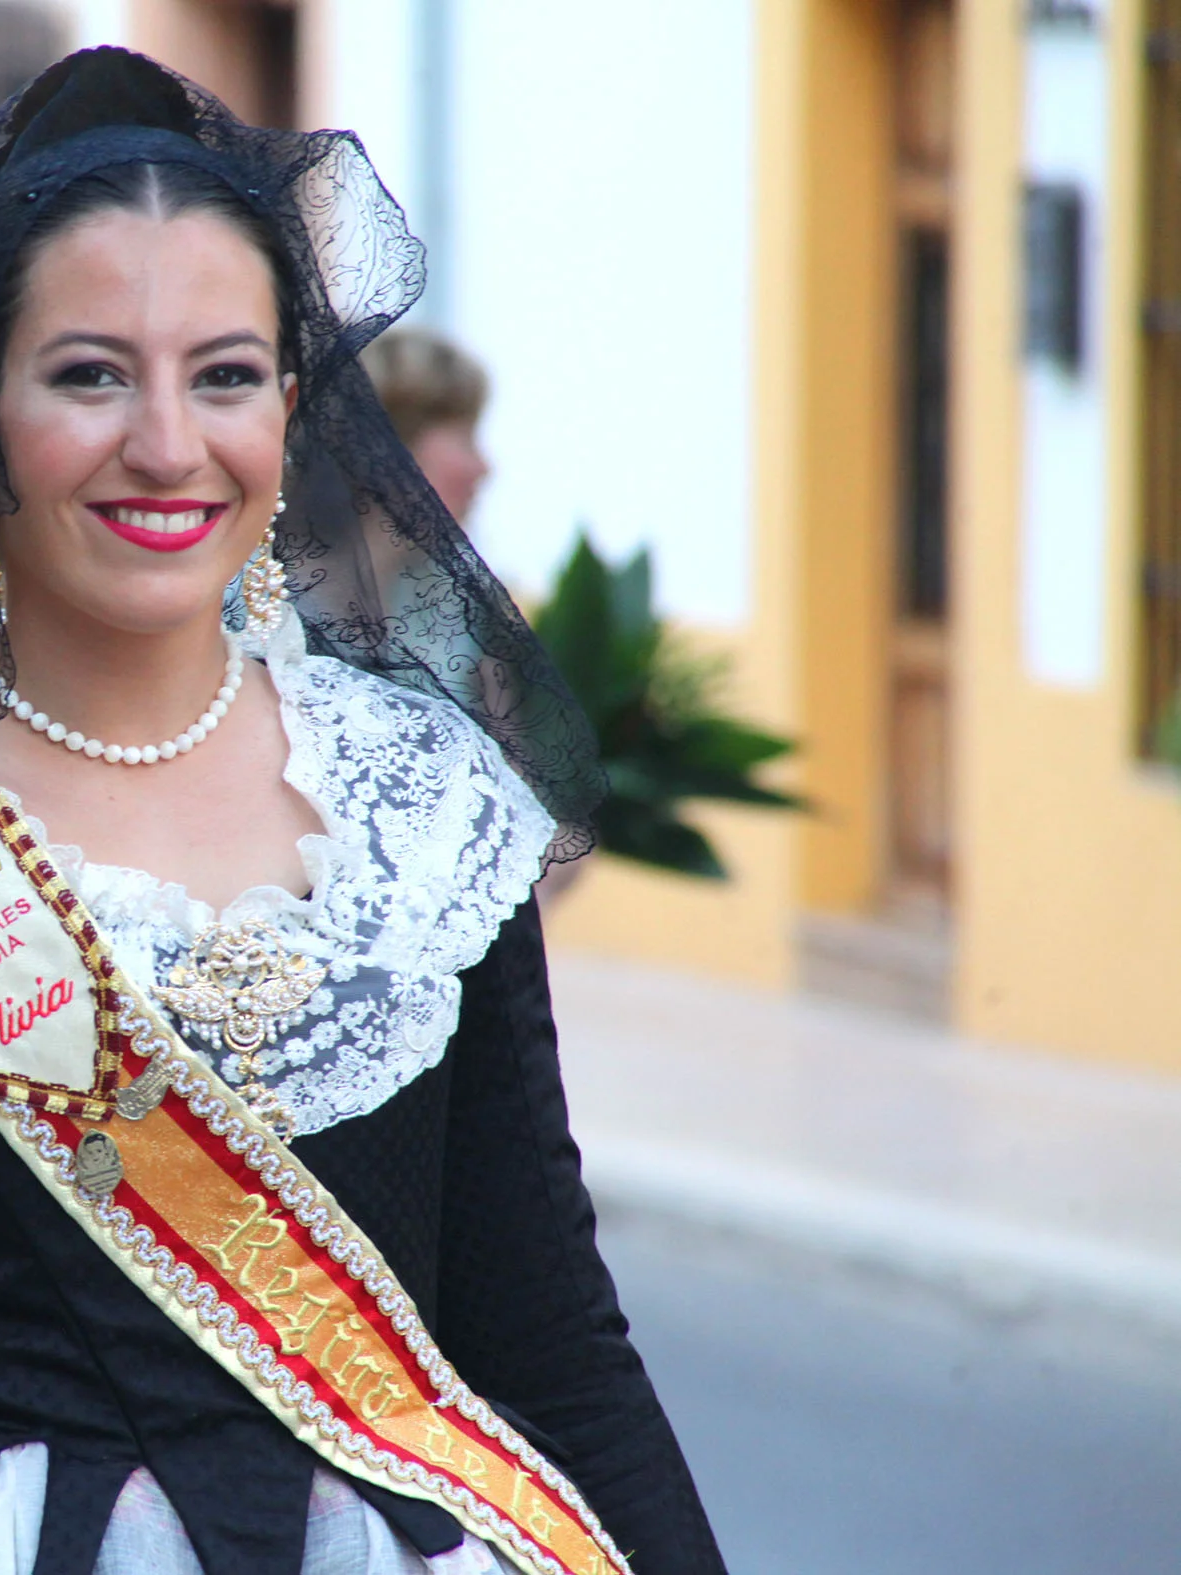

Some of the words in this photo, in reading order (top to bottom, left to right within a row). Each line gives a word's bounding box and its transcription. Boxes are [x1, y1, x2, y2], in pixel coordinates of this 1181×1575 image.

[201, 1193, 409, 1420] Regina
[417, 1405, 489, 1489] de
[510, 1462, 562, 1544] la
